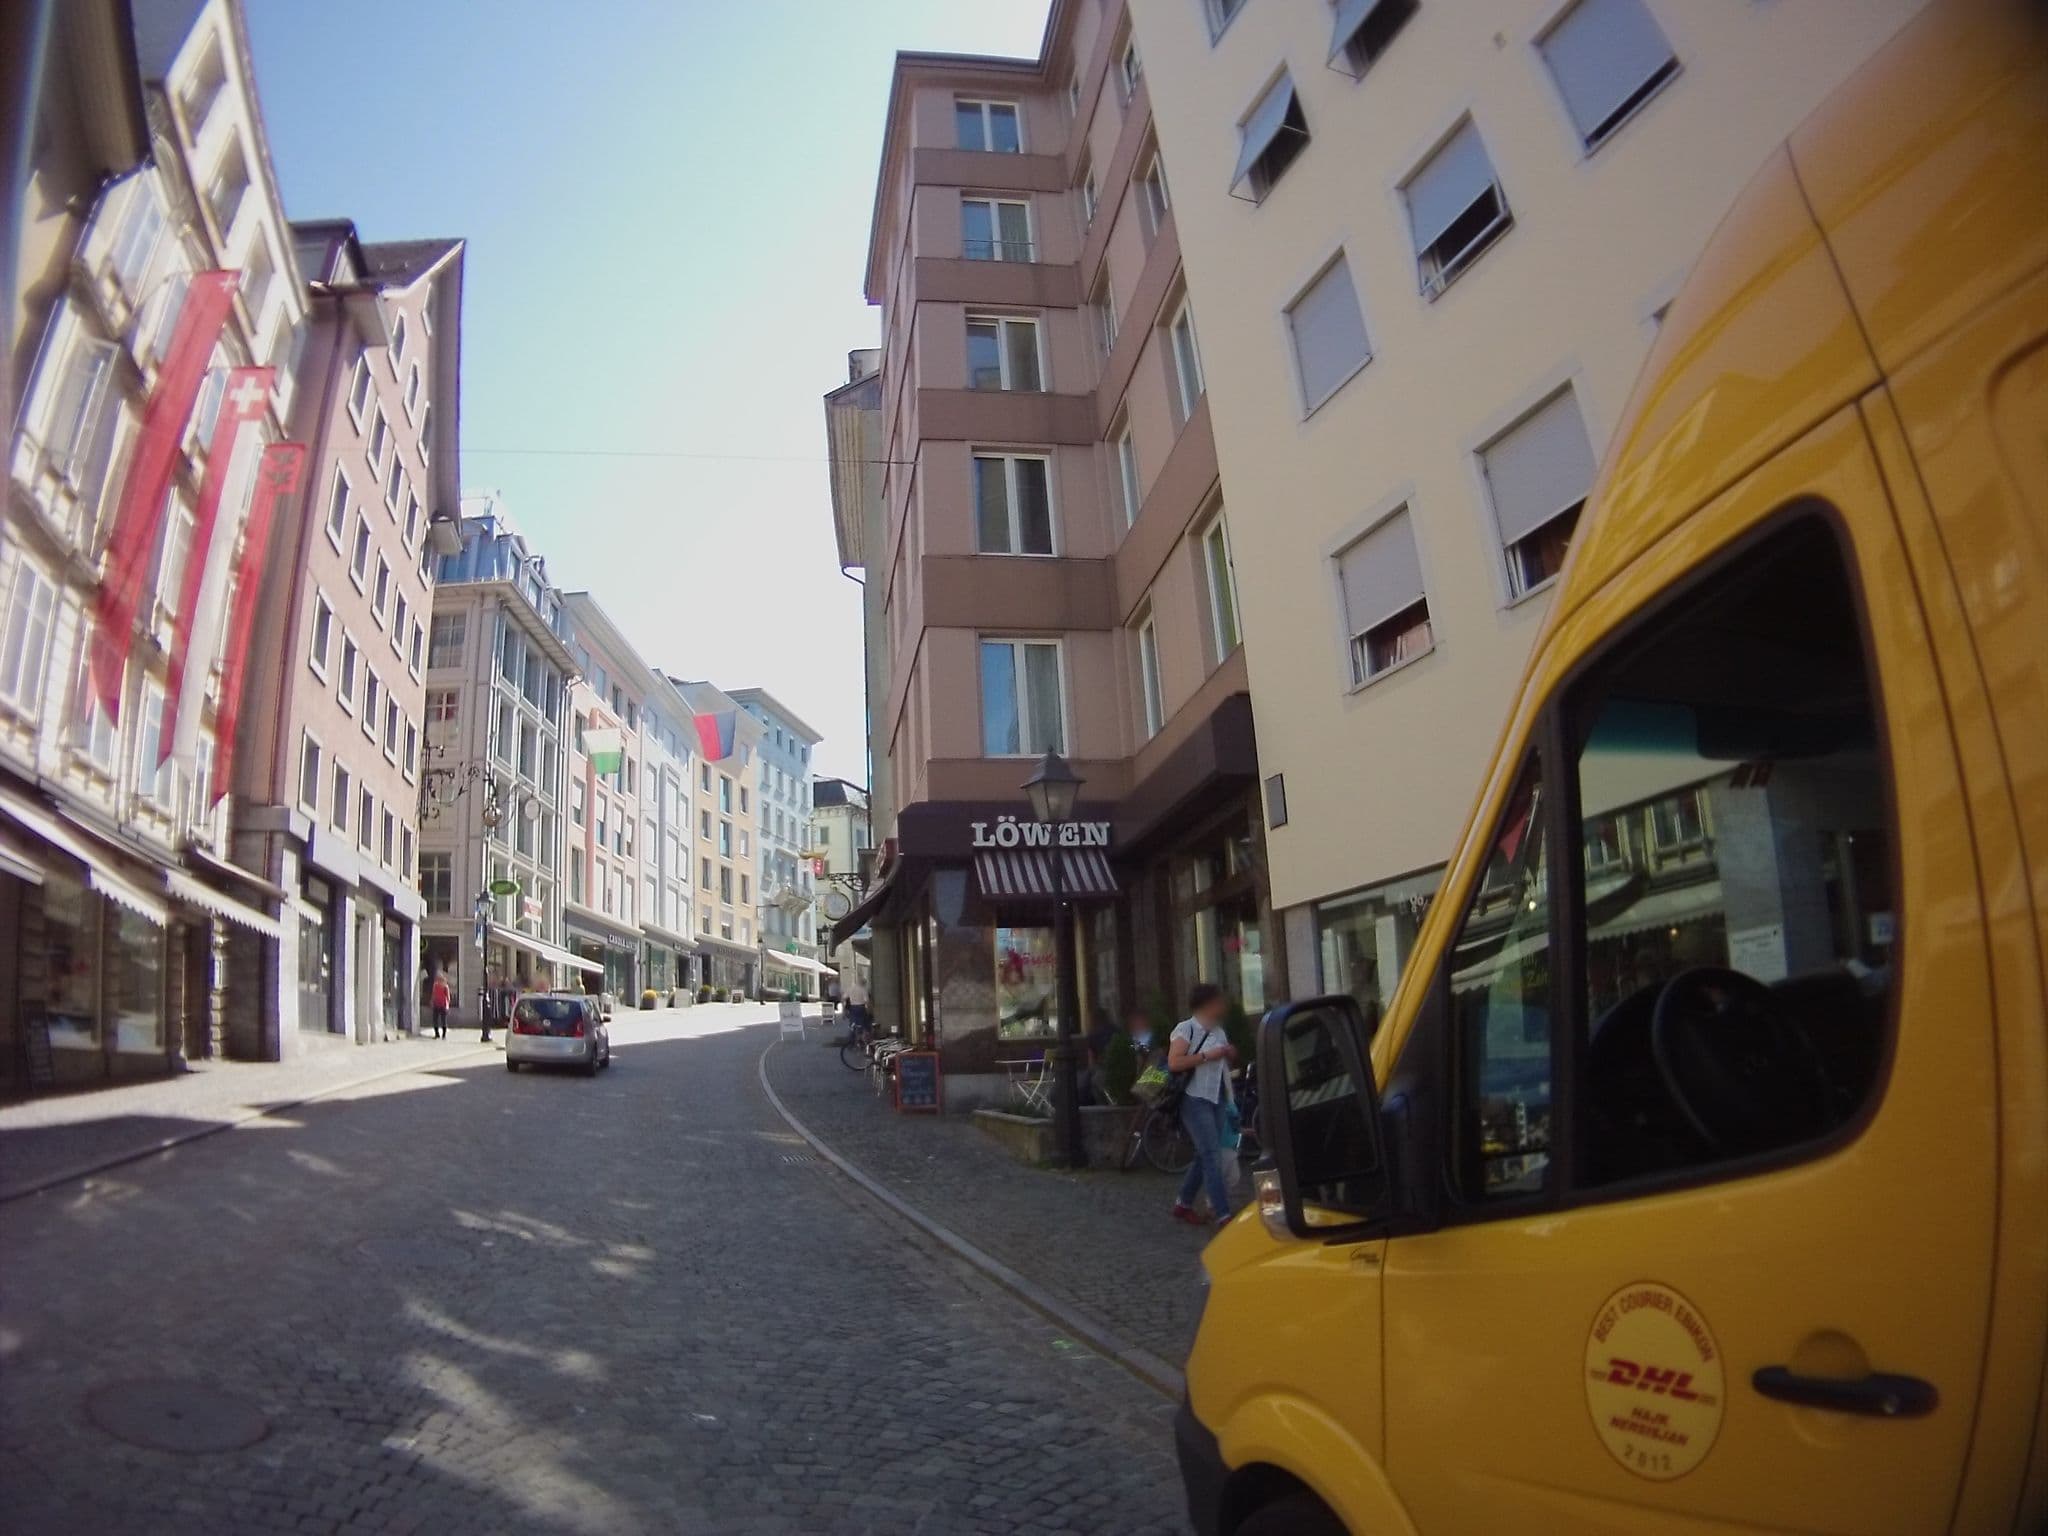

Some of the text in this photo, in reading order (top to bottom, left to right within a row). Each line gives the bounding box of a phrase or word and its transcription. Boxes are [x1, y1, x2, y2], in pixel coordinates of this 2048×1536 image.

[971, 815, 1110, 848] LÖWEN
[1620, 1290, 1674, 1316] COURIER
[1607, 1358, 1699, 1401] DHL
